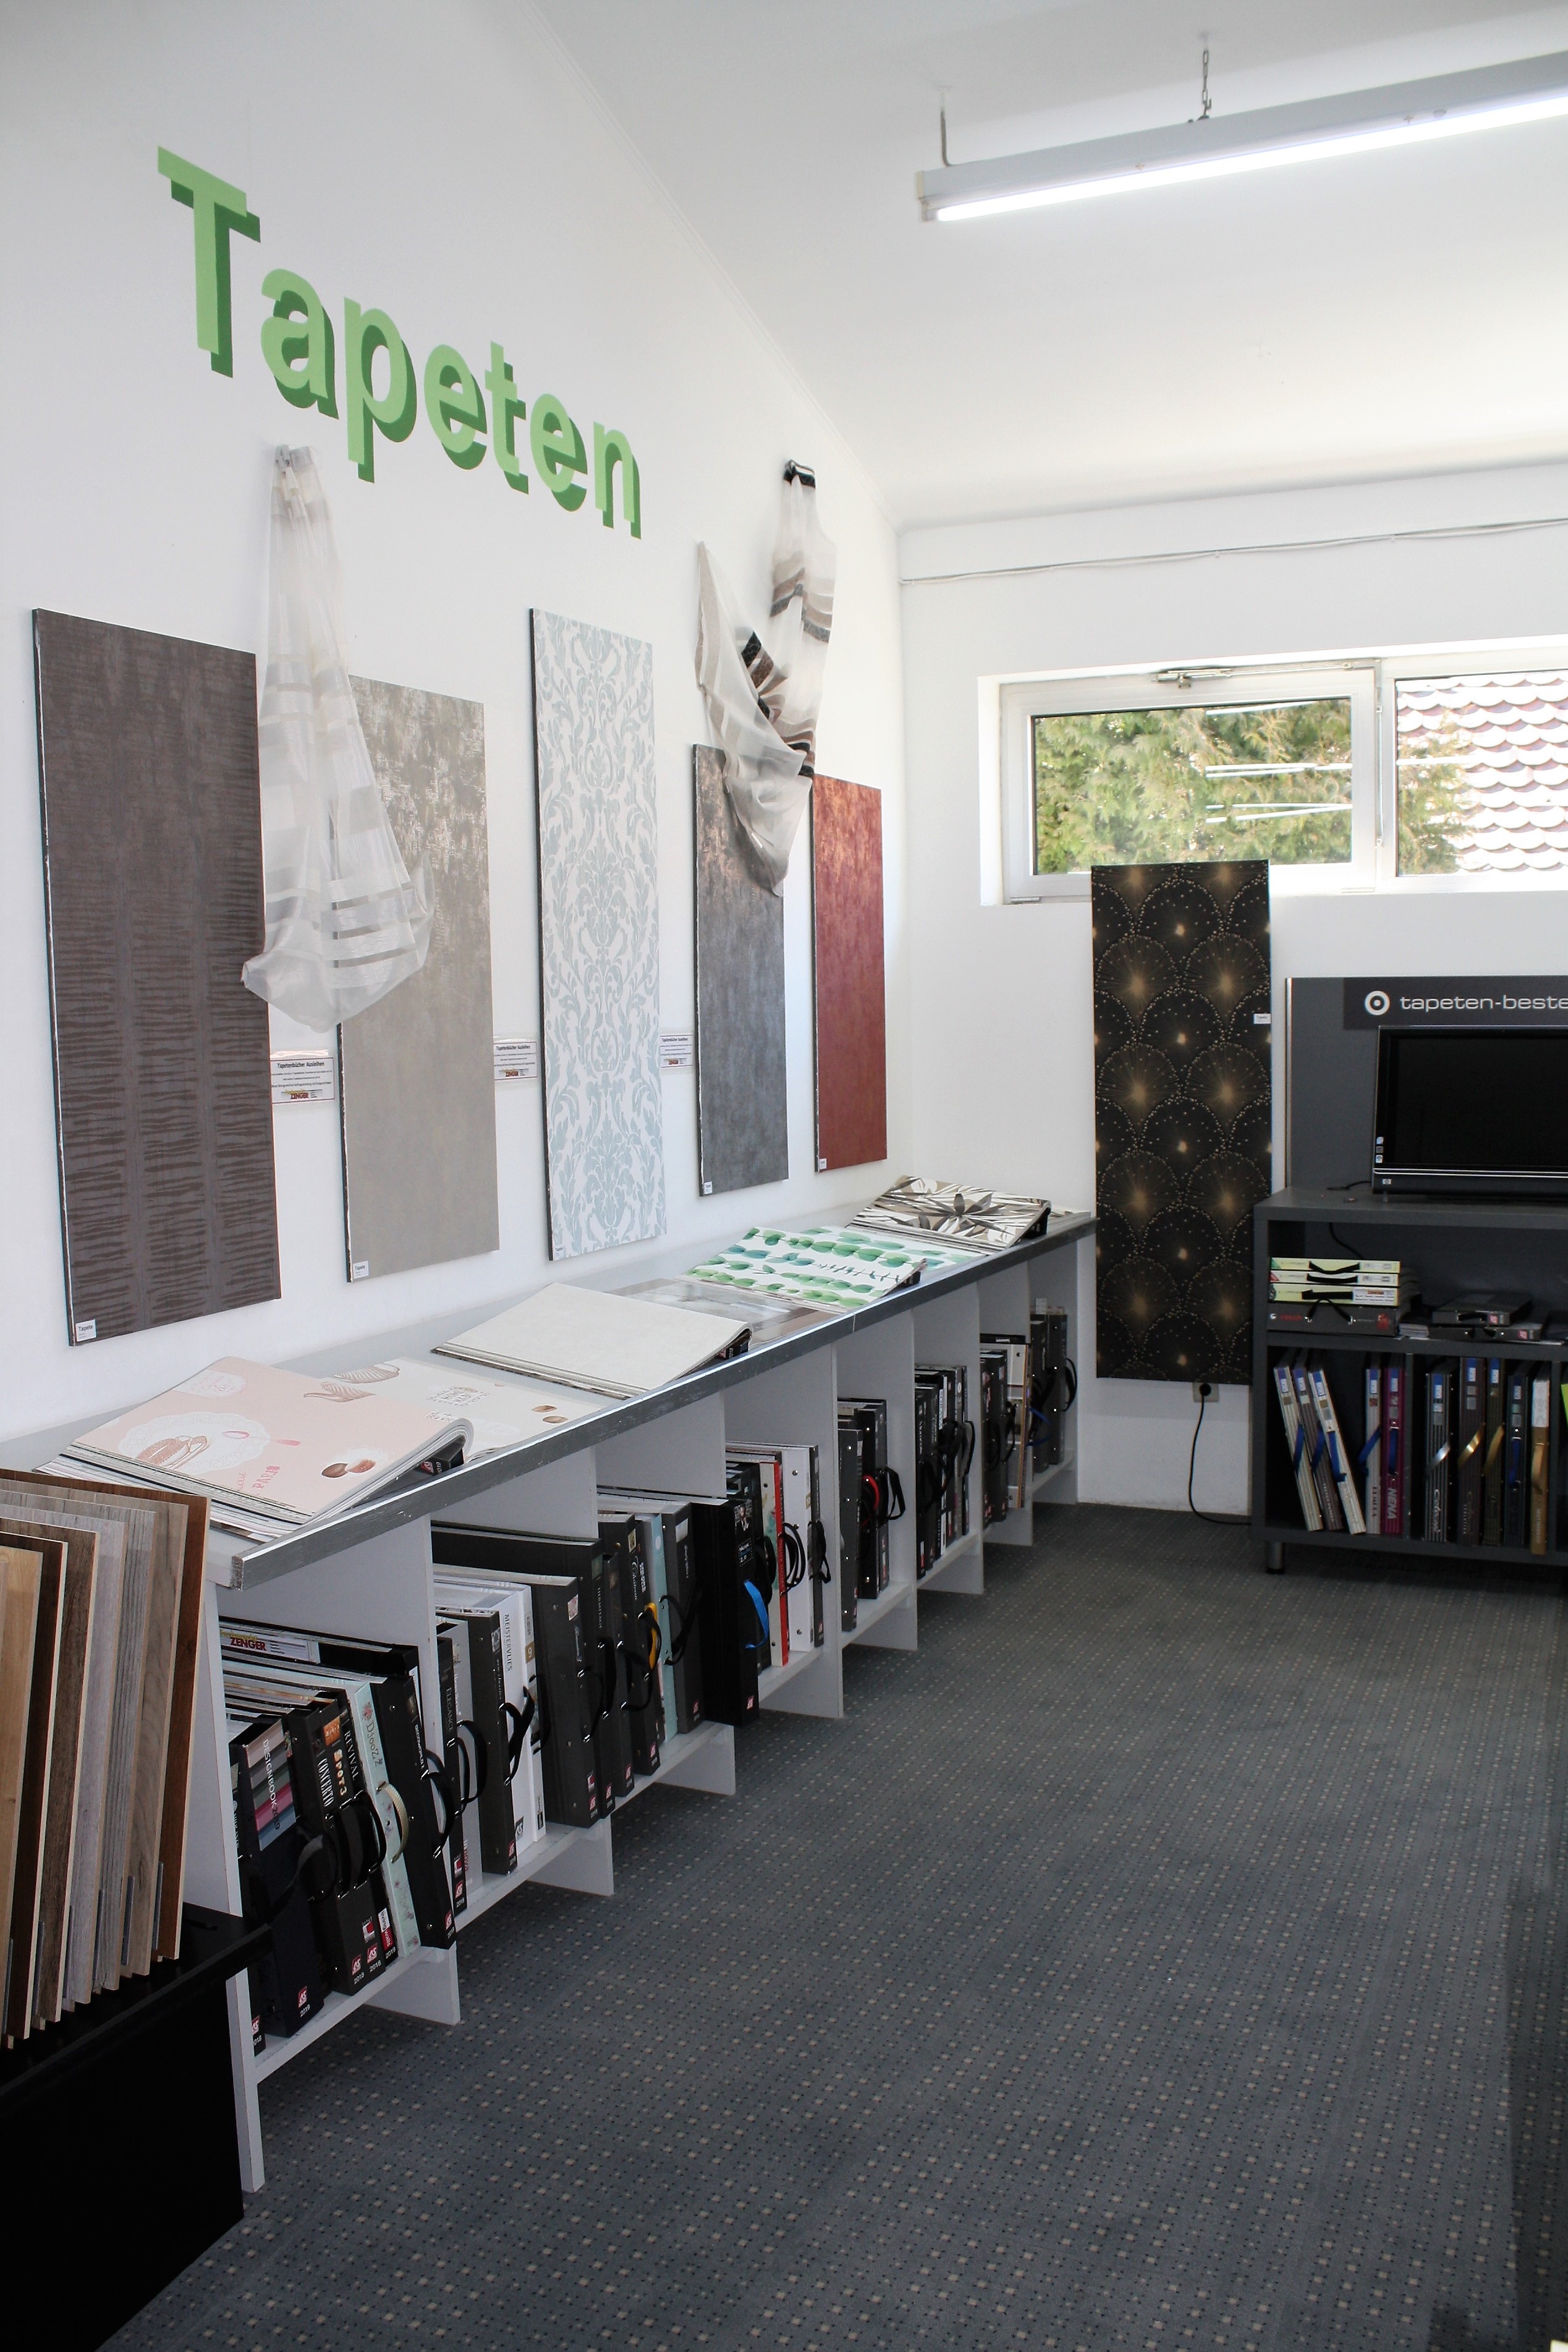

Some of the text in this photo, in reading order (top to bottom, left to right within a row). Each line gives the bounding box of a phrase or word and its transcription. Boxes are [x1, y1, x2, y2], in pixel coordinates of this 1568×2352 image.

[158, 146, 641, 540] Tapeten
[231, 1637, 266, 1651] ZENGER
[504, 1614, 513, 1671] MEISTERVLIES
[262, 1738, 277, 1809] DESIGNBOOK
[344, 1730, 360, 1781] REVIVAL
[317, 1757, 334, 1807] CONCERTO
[354, 1971, 365, 1985] 2018
[369, 1959, 382, 1972] 2018
[300, 2004, 310, 2018] 2019
